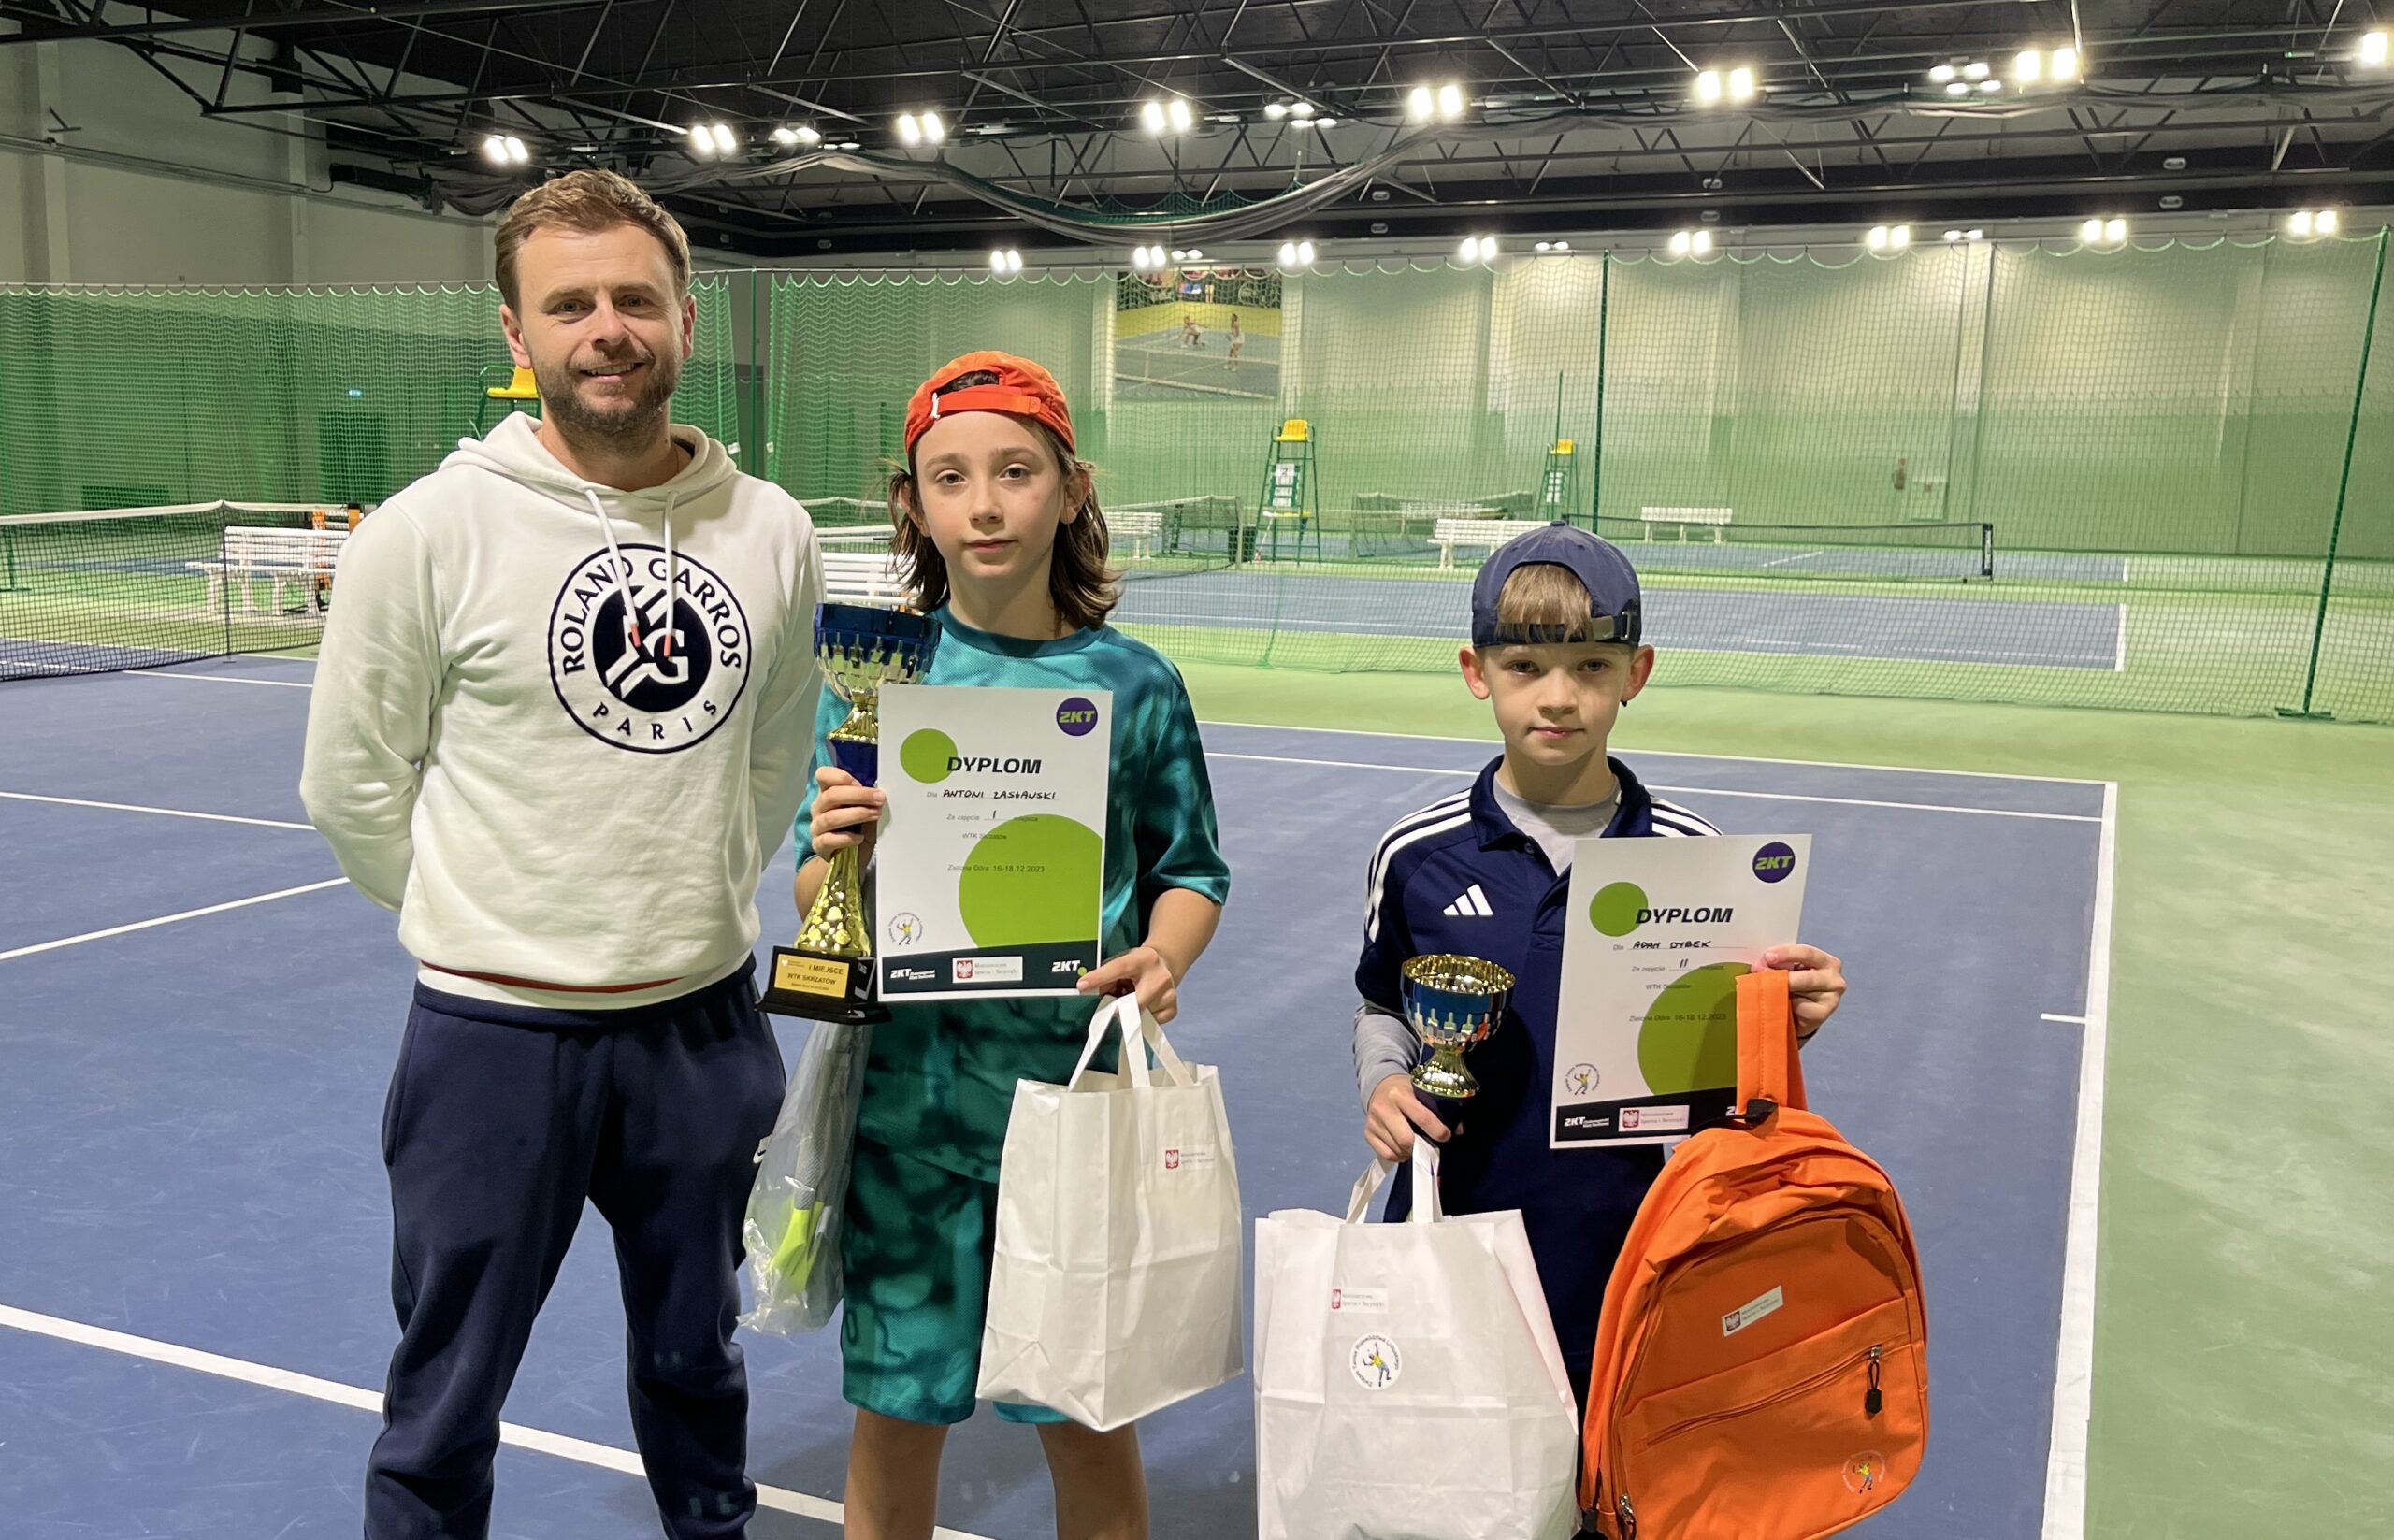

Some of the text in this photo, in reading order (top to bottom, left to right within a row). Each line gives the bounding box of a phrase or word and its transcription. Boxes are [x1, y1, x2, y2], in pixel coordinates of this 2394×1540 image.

[560, 556, 742, 675] ROLAND GARROS
[592, 700, 717, 740] PARIS
[1059, 711, 1095, 724] ZKT
[946, 756, 1042, 774] DYPLOM
[943, 789, 985, 799] ANTONI
[1754, 855, 1794, 871] ZKT
[1636, 907, 1734, 925] DYPLOM
[1669, 940, 1711, 949] DYBEK
[813, 965, 844, 975] MIEJSCE
[1051, 959, 1081, 972] ZKT
[890, 968, 912, 979] ZKT
[1564, 1116, 1586, 1128] ZKT
